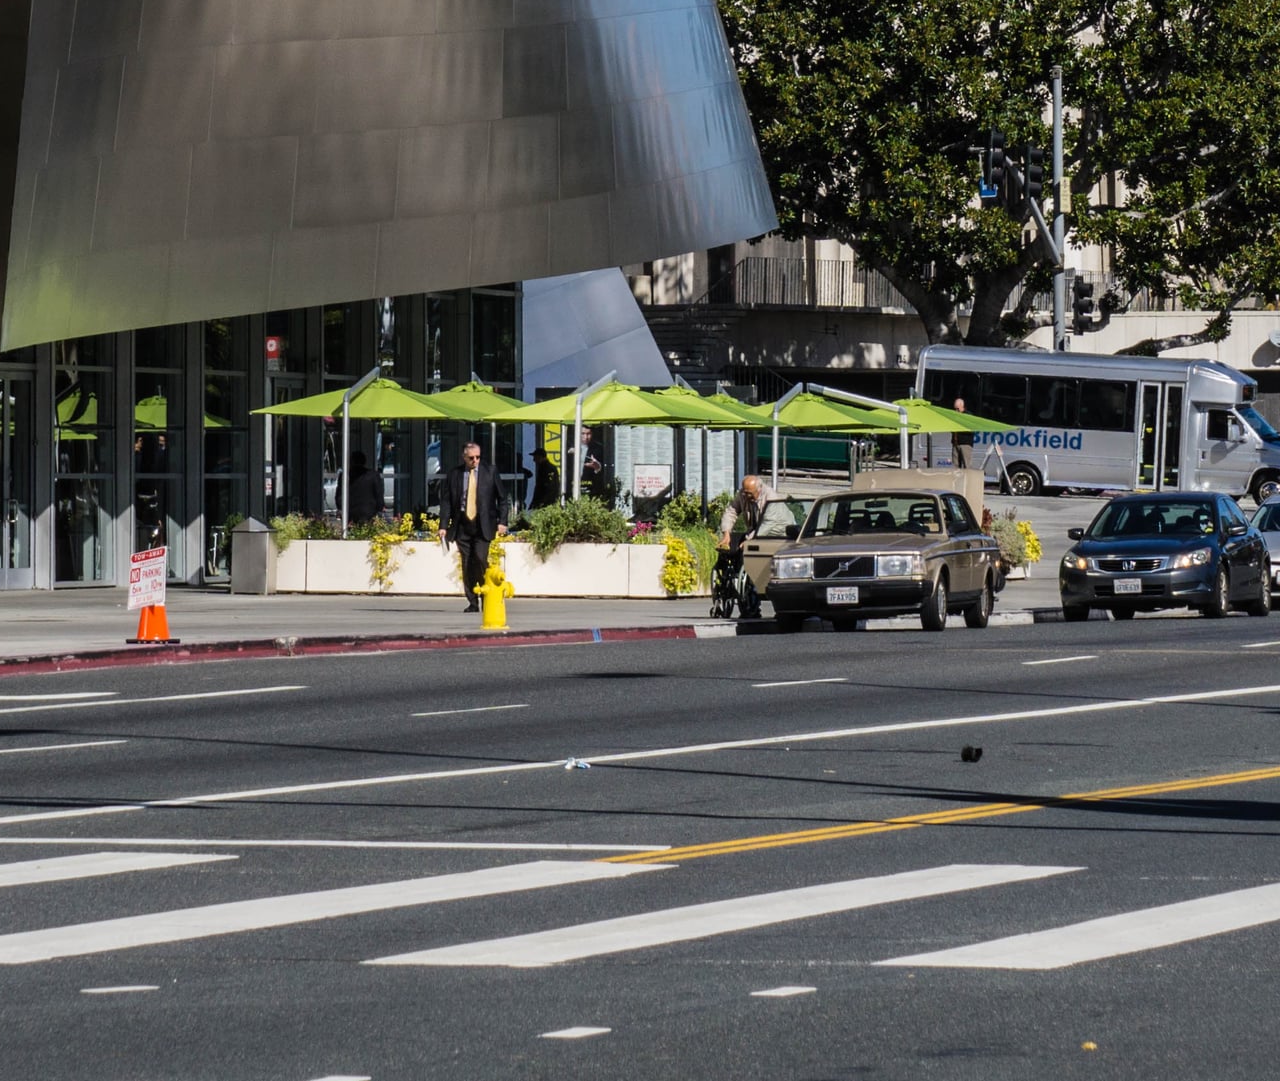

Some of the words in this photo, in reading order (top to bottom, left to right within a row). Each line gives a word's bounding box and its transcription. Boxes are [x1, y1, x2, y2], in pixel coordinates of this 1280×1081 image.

[972, 429, 1083, 450] Brookfield
[134, 549, 163, 561] TOW-AWAY
[131, 569, 140, 583] NO
[142, 567, 162, 579] PARKING
